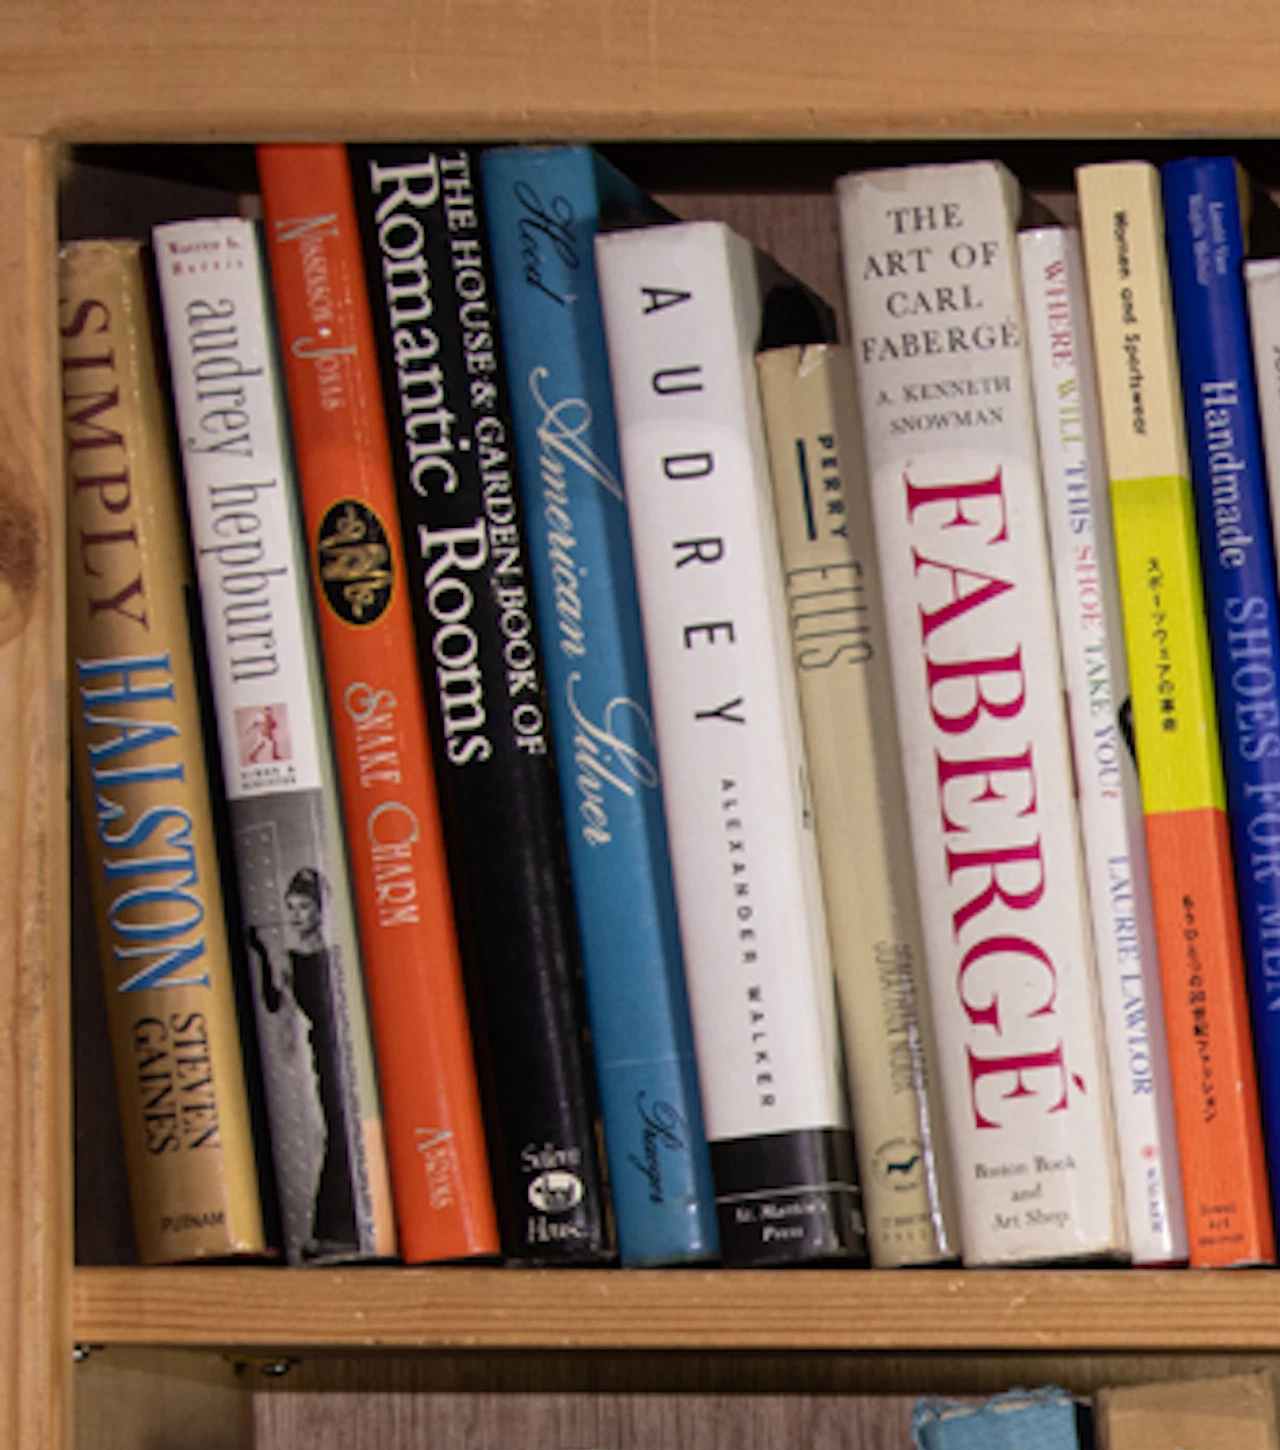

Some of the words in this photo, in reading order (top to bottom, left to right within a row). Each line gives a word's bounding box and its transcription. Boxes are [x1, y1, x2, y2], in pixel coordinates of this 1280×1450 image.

[441, 150, 481, 231] THE
[887, 204, 964, 235] THE
[451, 238, 499, 376] HOUSE
[862, 249, 931, 280] ART
[950, 242, 1000, 268] OF
[886, 285, 984, 318] CARL
[1043, 260, 1076, 368] WHERE
[187, 299, 263, 458] audrey
[369, 154, 471, 497] Romantic
[860, 319, 1022, 364] FABERGÉ
[470, 379, 499, 407] &
[889, 407, 1003, 434] SNOWMAN
[902, 375, 1013, 404] KENNETH
[1057, 380, 1083, 452] WILL
[61, 300, 150, 632] SIMPLY
[473, 415, 524, 579] GARDEN
[641, 285, 745, 726] AUDREY
[817, 433, 849, 540] PERRY
[1063, 457, 1090, 535] THIS
[1199, 380, 1253, 569] Handmade
[199, 478, 288, 682] hepburn
[787, 561, 875, 672] ELLIS
[1070, 544, 1104, 631] SHOE
[417, 519, 492, 766] Rooms
[493, 583, 537, 696] BOOK
[1082, 635, 1113, 719] TAKE
[512, 704, 547, 757] OF
[77, 654, 211, 994] HALSTON
[903, 459, 1090, 1131] FABERGÉ
[721, 778, 756, 964] ALEXANDER
[748, 985, 774, 1109] WALKER
[1108, 856, 1140, 964] LAURIE
[134, 1016, 179, 1155] GAINES
[171, 1011, 219, 1150] STEVEN
[1120, 971, 1155, 1096] LAWLOR
